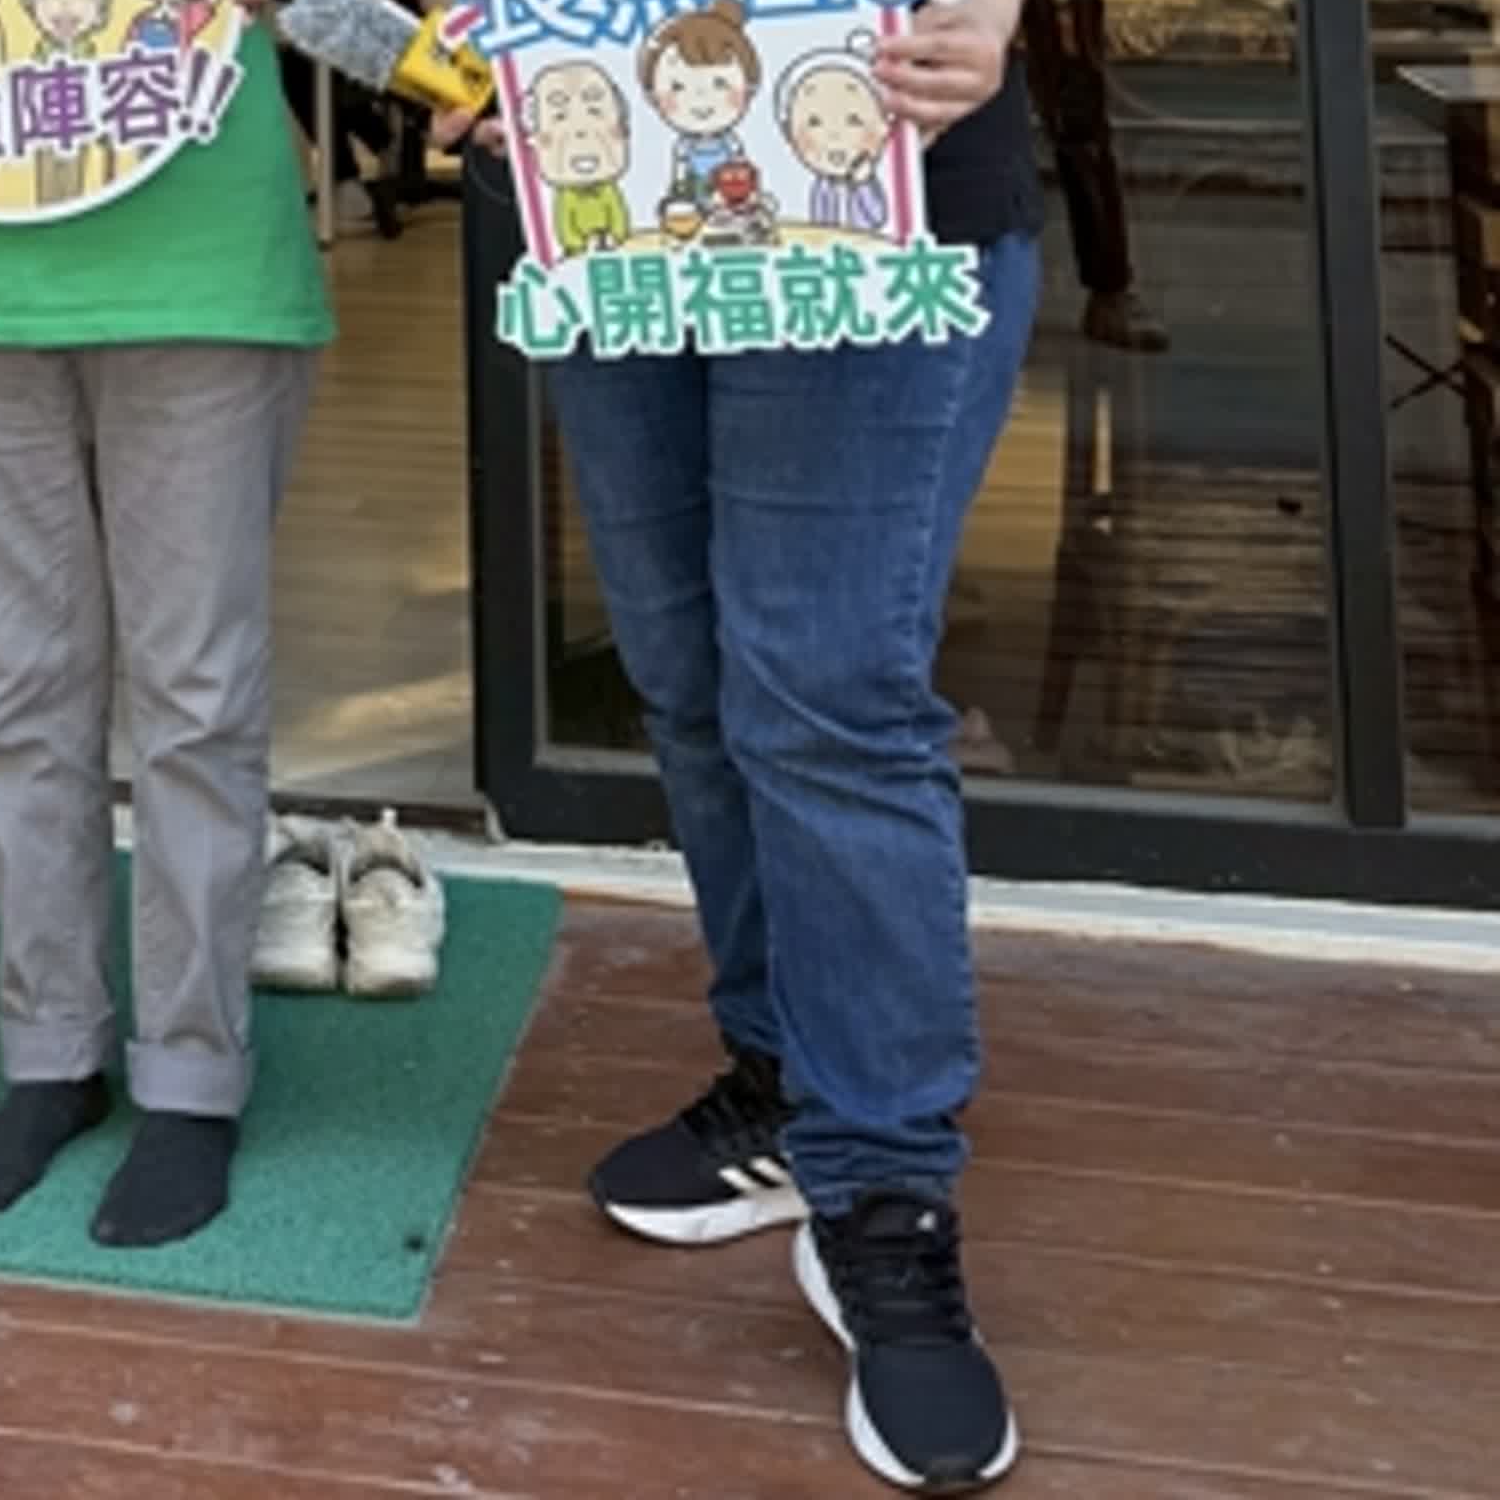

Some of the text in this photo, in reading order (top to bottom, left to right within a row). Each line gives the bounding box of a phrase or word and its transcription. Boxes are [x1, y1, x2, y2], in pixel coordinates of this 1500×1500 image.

[501, 239, 985, 350] 心開福就來
